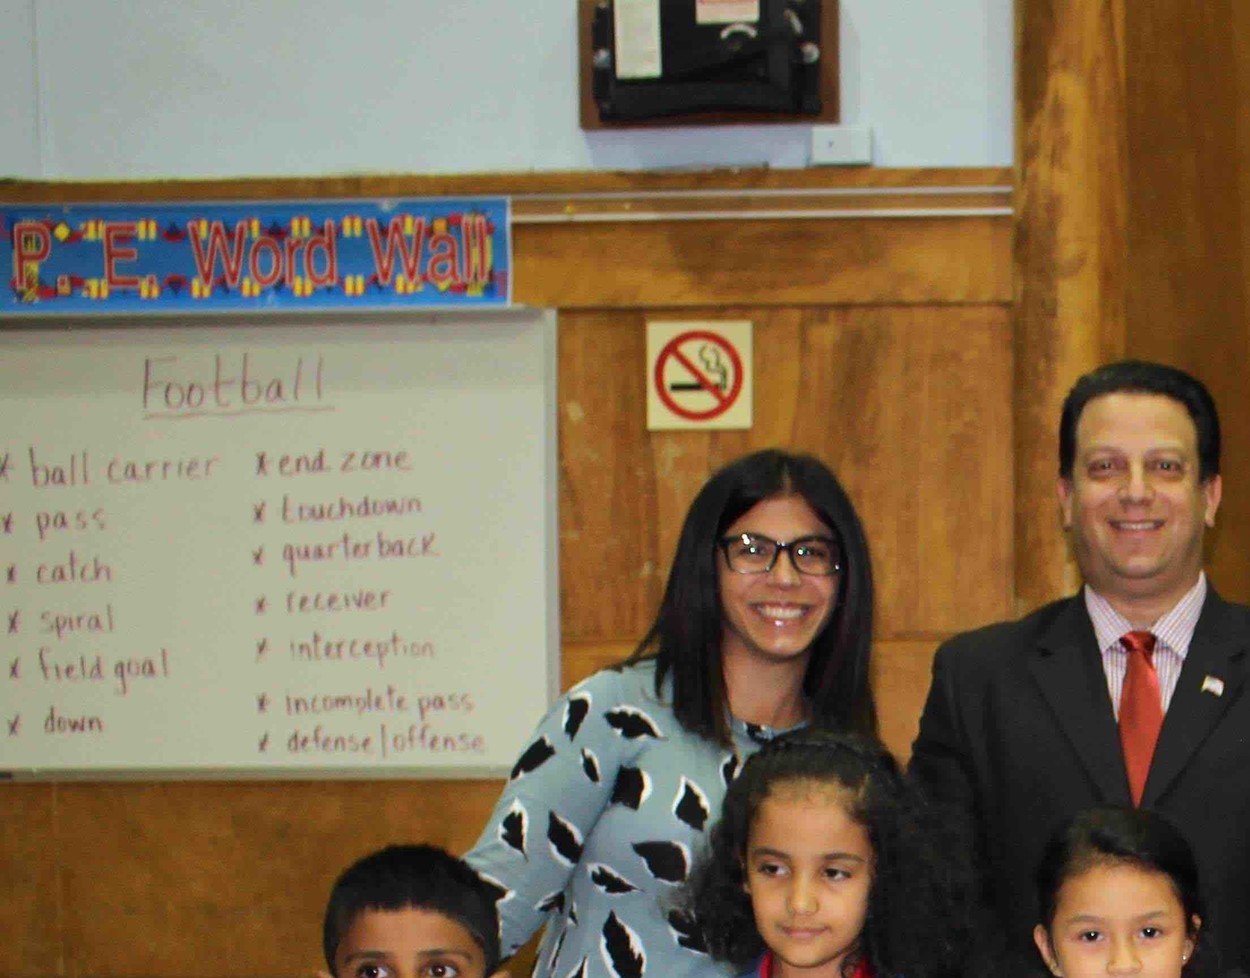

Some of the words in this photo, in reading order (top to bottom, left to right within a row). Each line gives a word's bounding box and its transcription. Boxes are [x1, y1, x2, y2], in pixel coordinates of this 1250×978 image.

[188, 219, 337, 287] Word
[366, 216, 491, 286] Wall
[143, 353, 324, 409] Football
[29, 447, 88, 487] ball
[107, 455, 219, 482] carrier
[279, 449, 329, 475] end
[340, 451, 411, 474] zone
[36, 507, 106, 540] pass
[282, 494, 422, 523] touchdown
[36, 550, 112, 584] catch
[282, 531, 440, 578] quarterback
[286, 590, 391, 613] receiver
[40, 603, 113, 639] spiral
[290, 631, 435, 669] interception
[39, 647, 104, 681] field
[113, 648, 168, 696] goal
[44, 706, 104, 733] down
[286, 685, 406, 716] incomplete
[418, 692, 474, 721] pass
